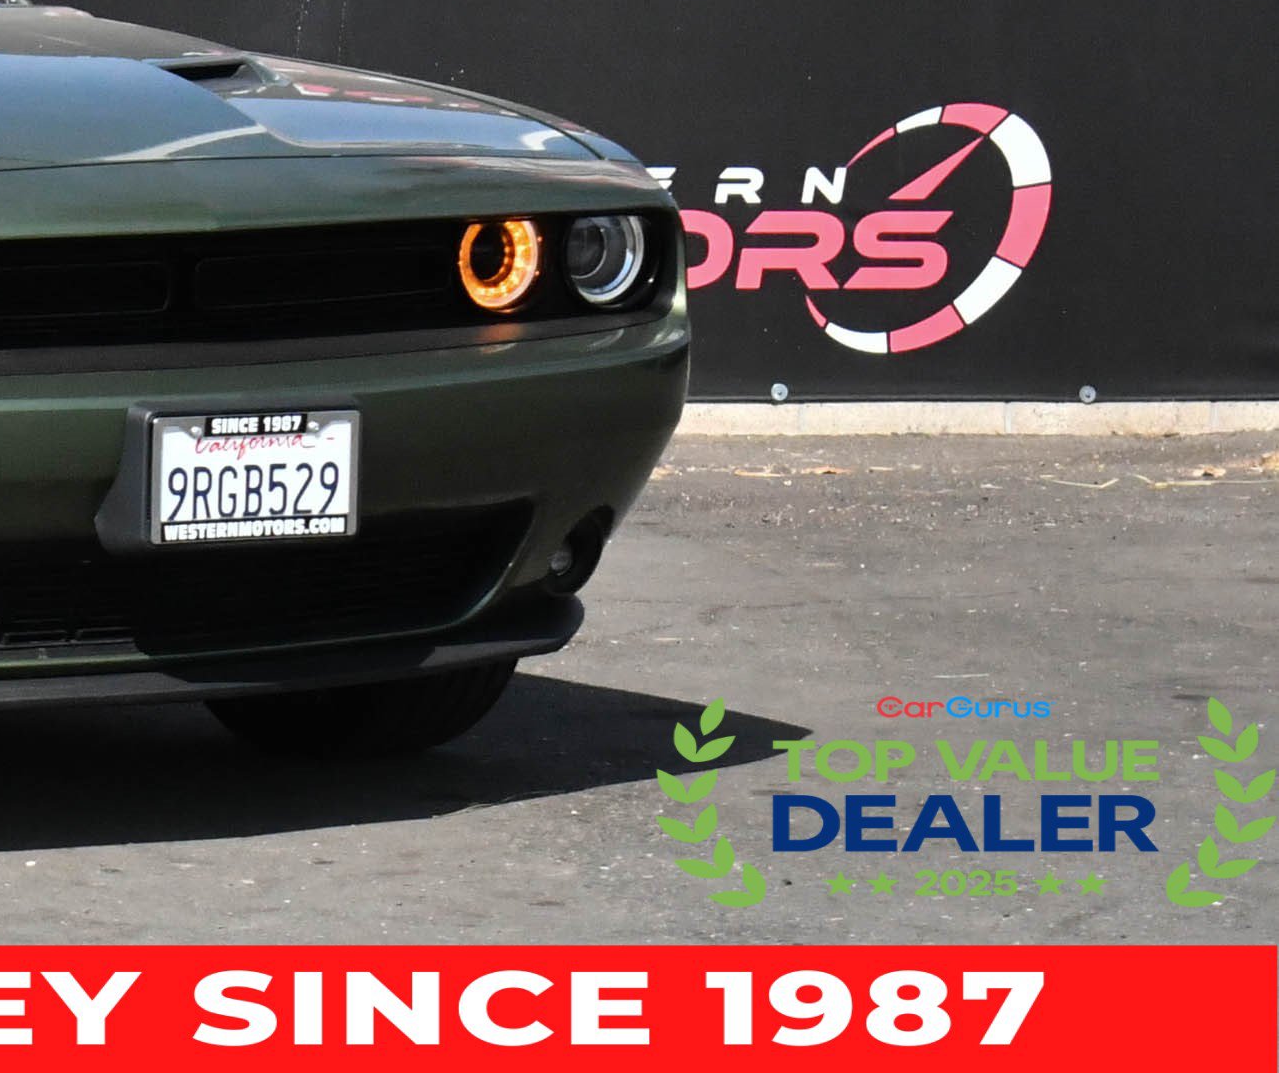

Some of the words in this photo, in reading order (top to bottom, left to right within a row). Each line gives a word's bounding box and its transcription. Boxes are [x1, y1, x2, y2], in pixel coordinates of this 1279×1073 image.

[210, 416, 259, 435] SINCE
[262, 415, 302, 432] 1987
[168, 460, 340, 521] 9RGB529
[163, 516, 346, 541] WESTERNMOTORS.COM
